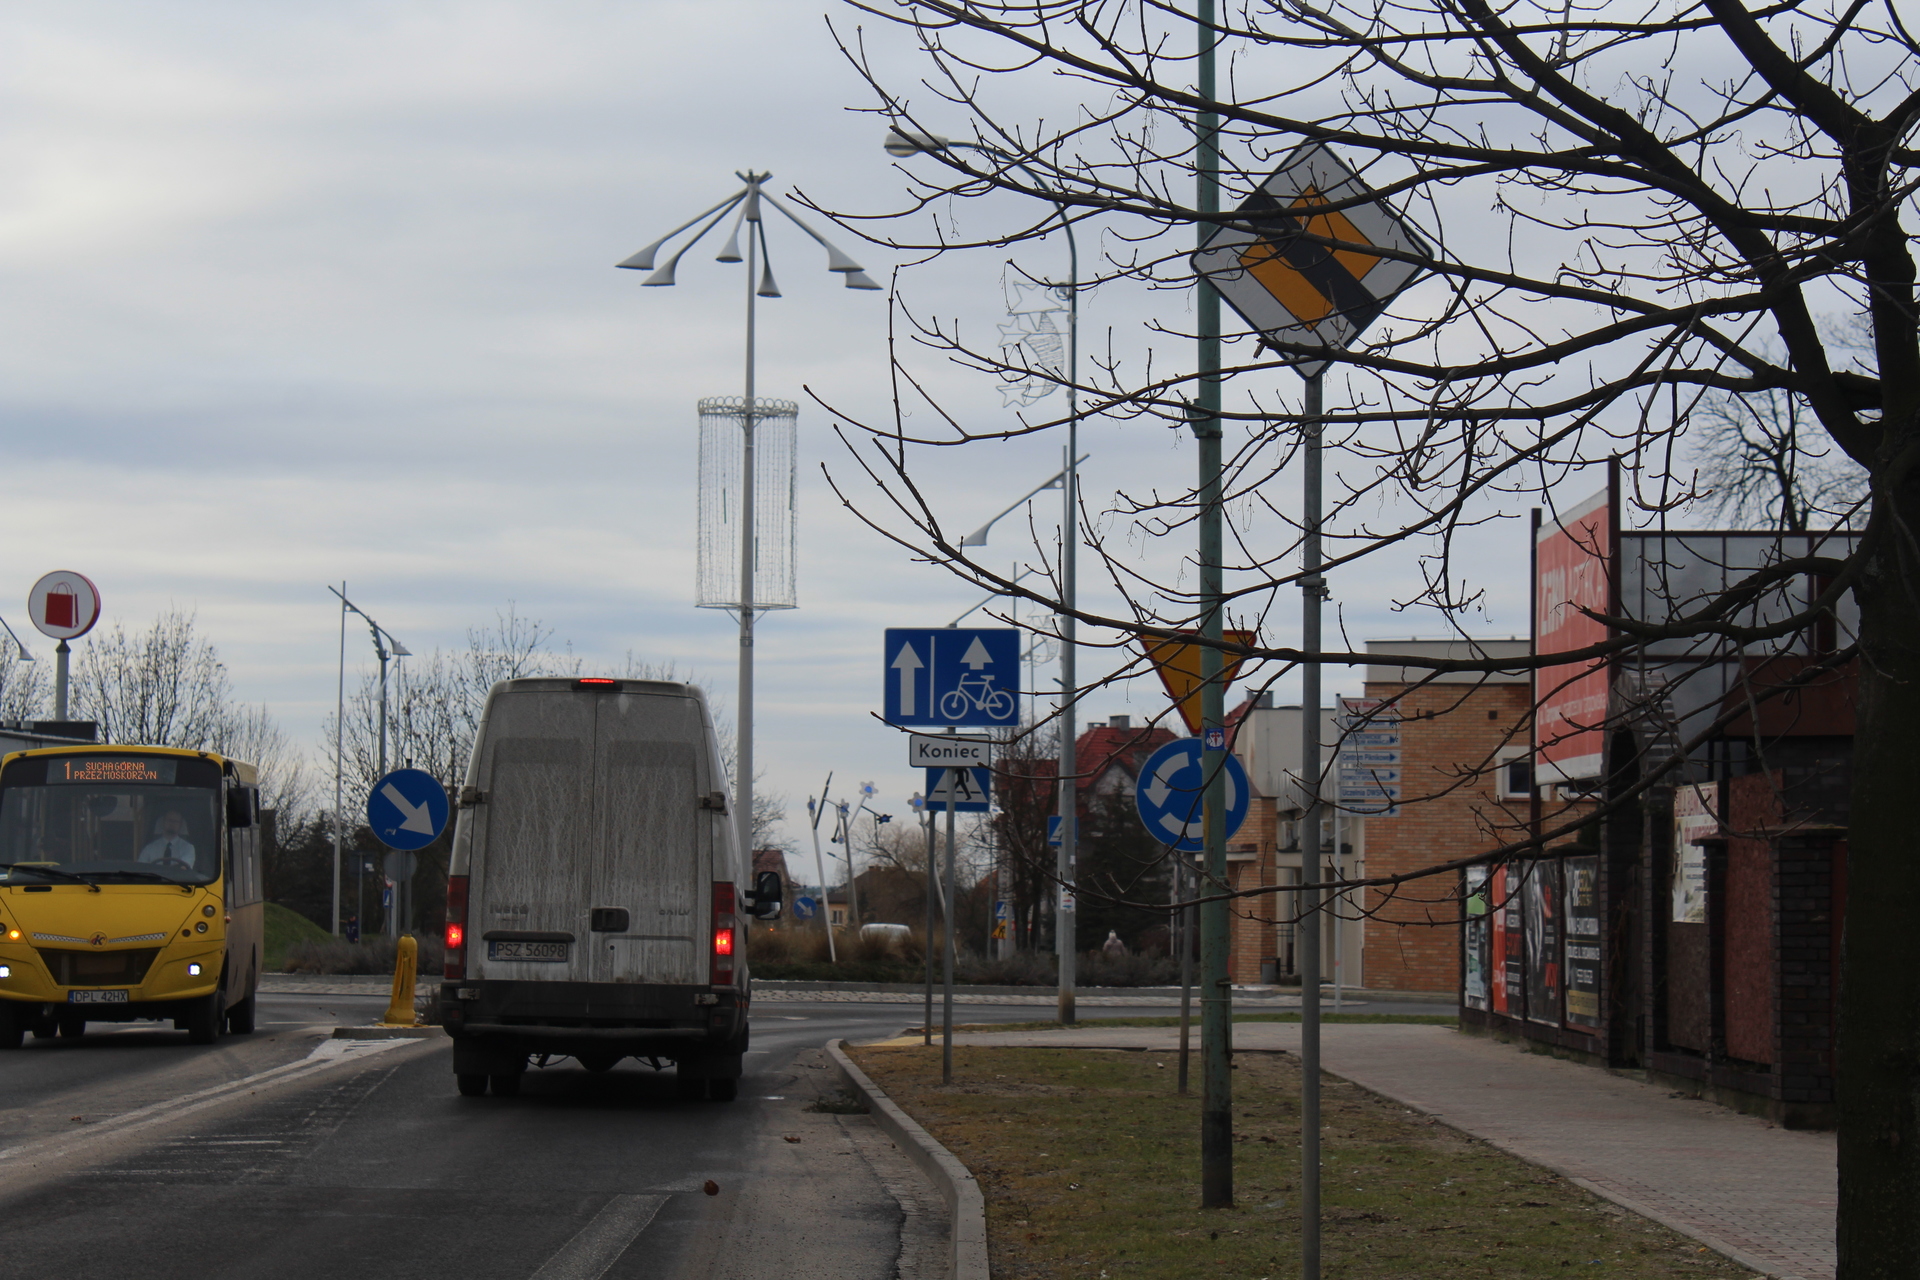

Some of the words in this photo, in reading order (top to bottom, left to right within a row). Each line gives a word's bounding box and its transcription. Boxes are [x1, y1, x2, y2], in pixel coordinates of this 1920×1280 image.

[919, 743, 979, 758] Koniec
[64, 761, 70, 780] 1
[85, 761, 113, 771] SUCHA
[114, 761, 145, 771] GÓRNA
[74, 771, 102, 780] PRZEZ
[103, 771, 157, 780] MOSKORZYN
[496, 943, 522, 957] PSZ
[525, 943, 565, 958] 56098
[75, 991, 97, 1002] DPL
[101, 991, 127, 1002] 42HX
